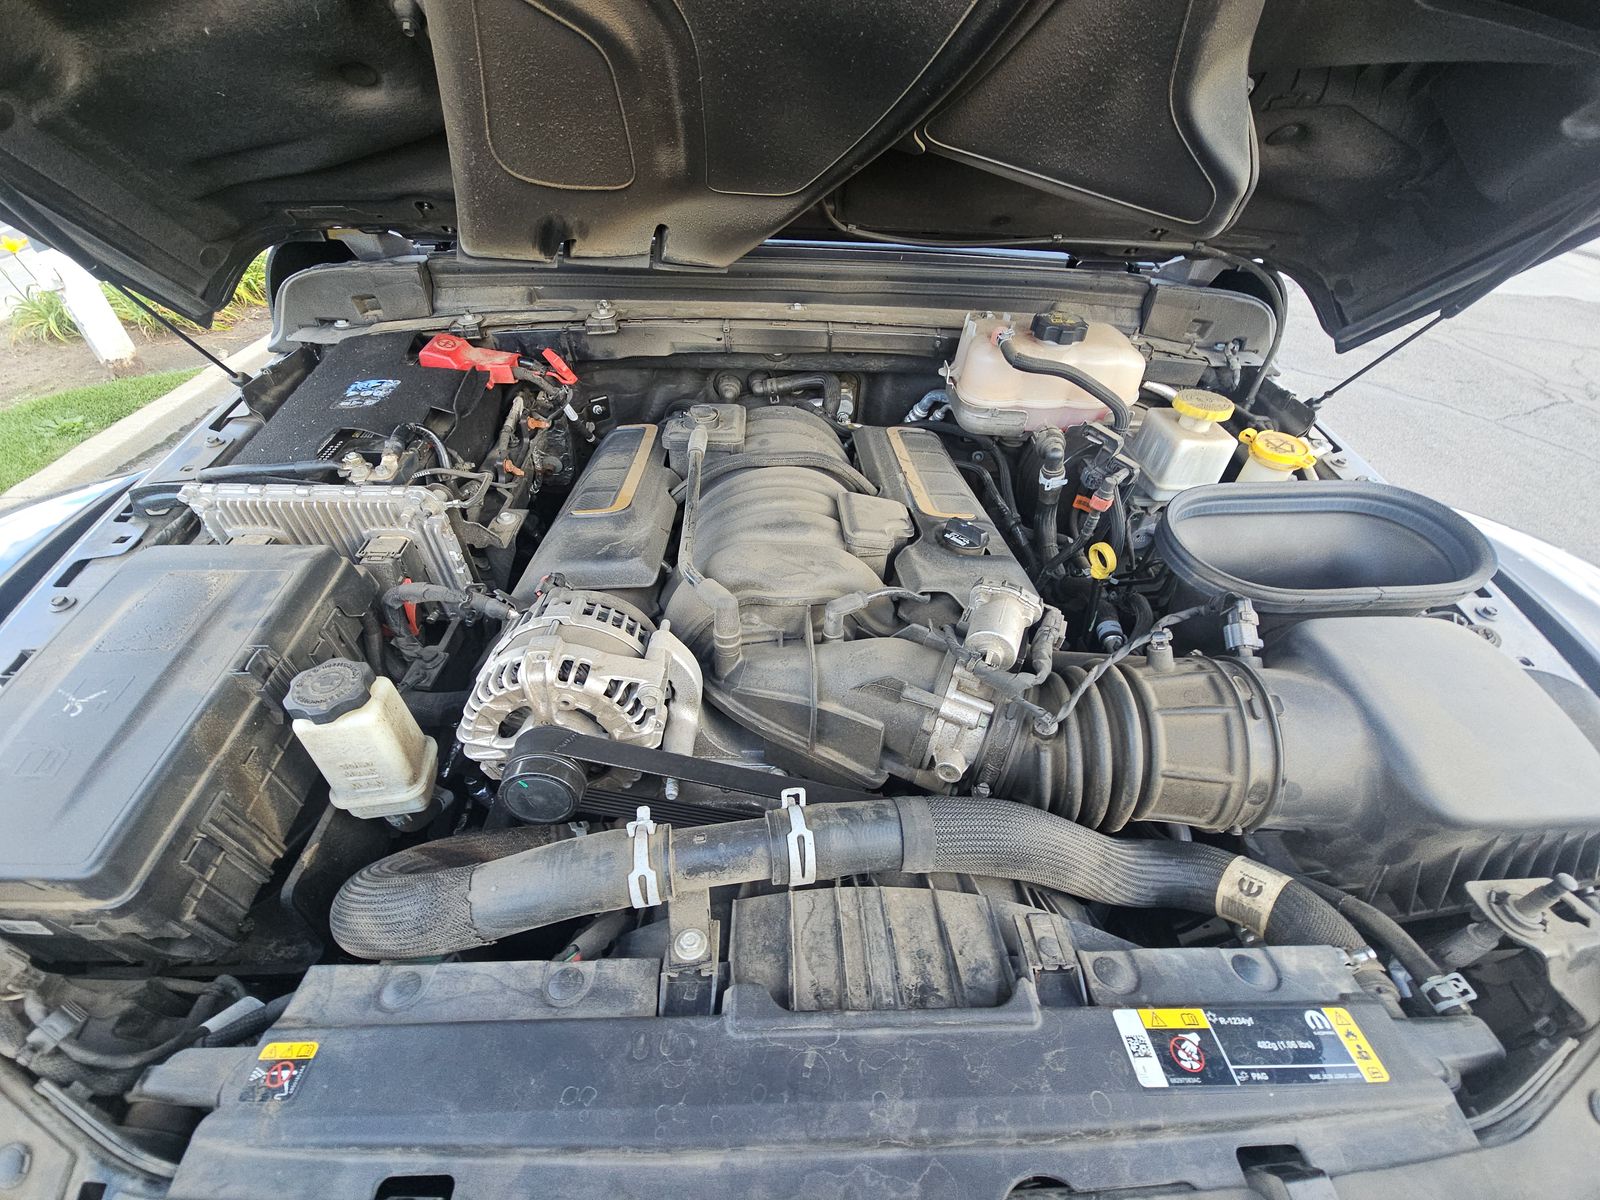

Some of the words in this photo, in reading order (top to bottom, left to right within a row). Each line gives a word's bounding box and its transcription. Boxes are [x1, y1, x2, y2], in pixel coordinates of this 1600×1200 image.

[1218, 1016, 1255, 1027] R-1234yf
[1256, 1040, 1279, 1051] 482g
[1296, 1040, 1316, 1050] lbs)
[1250, 1072, 1270, 1081] PAG
